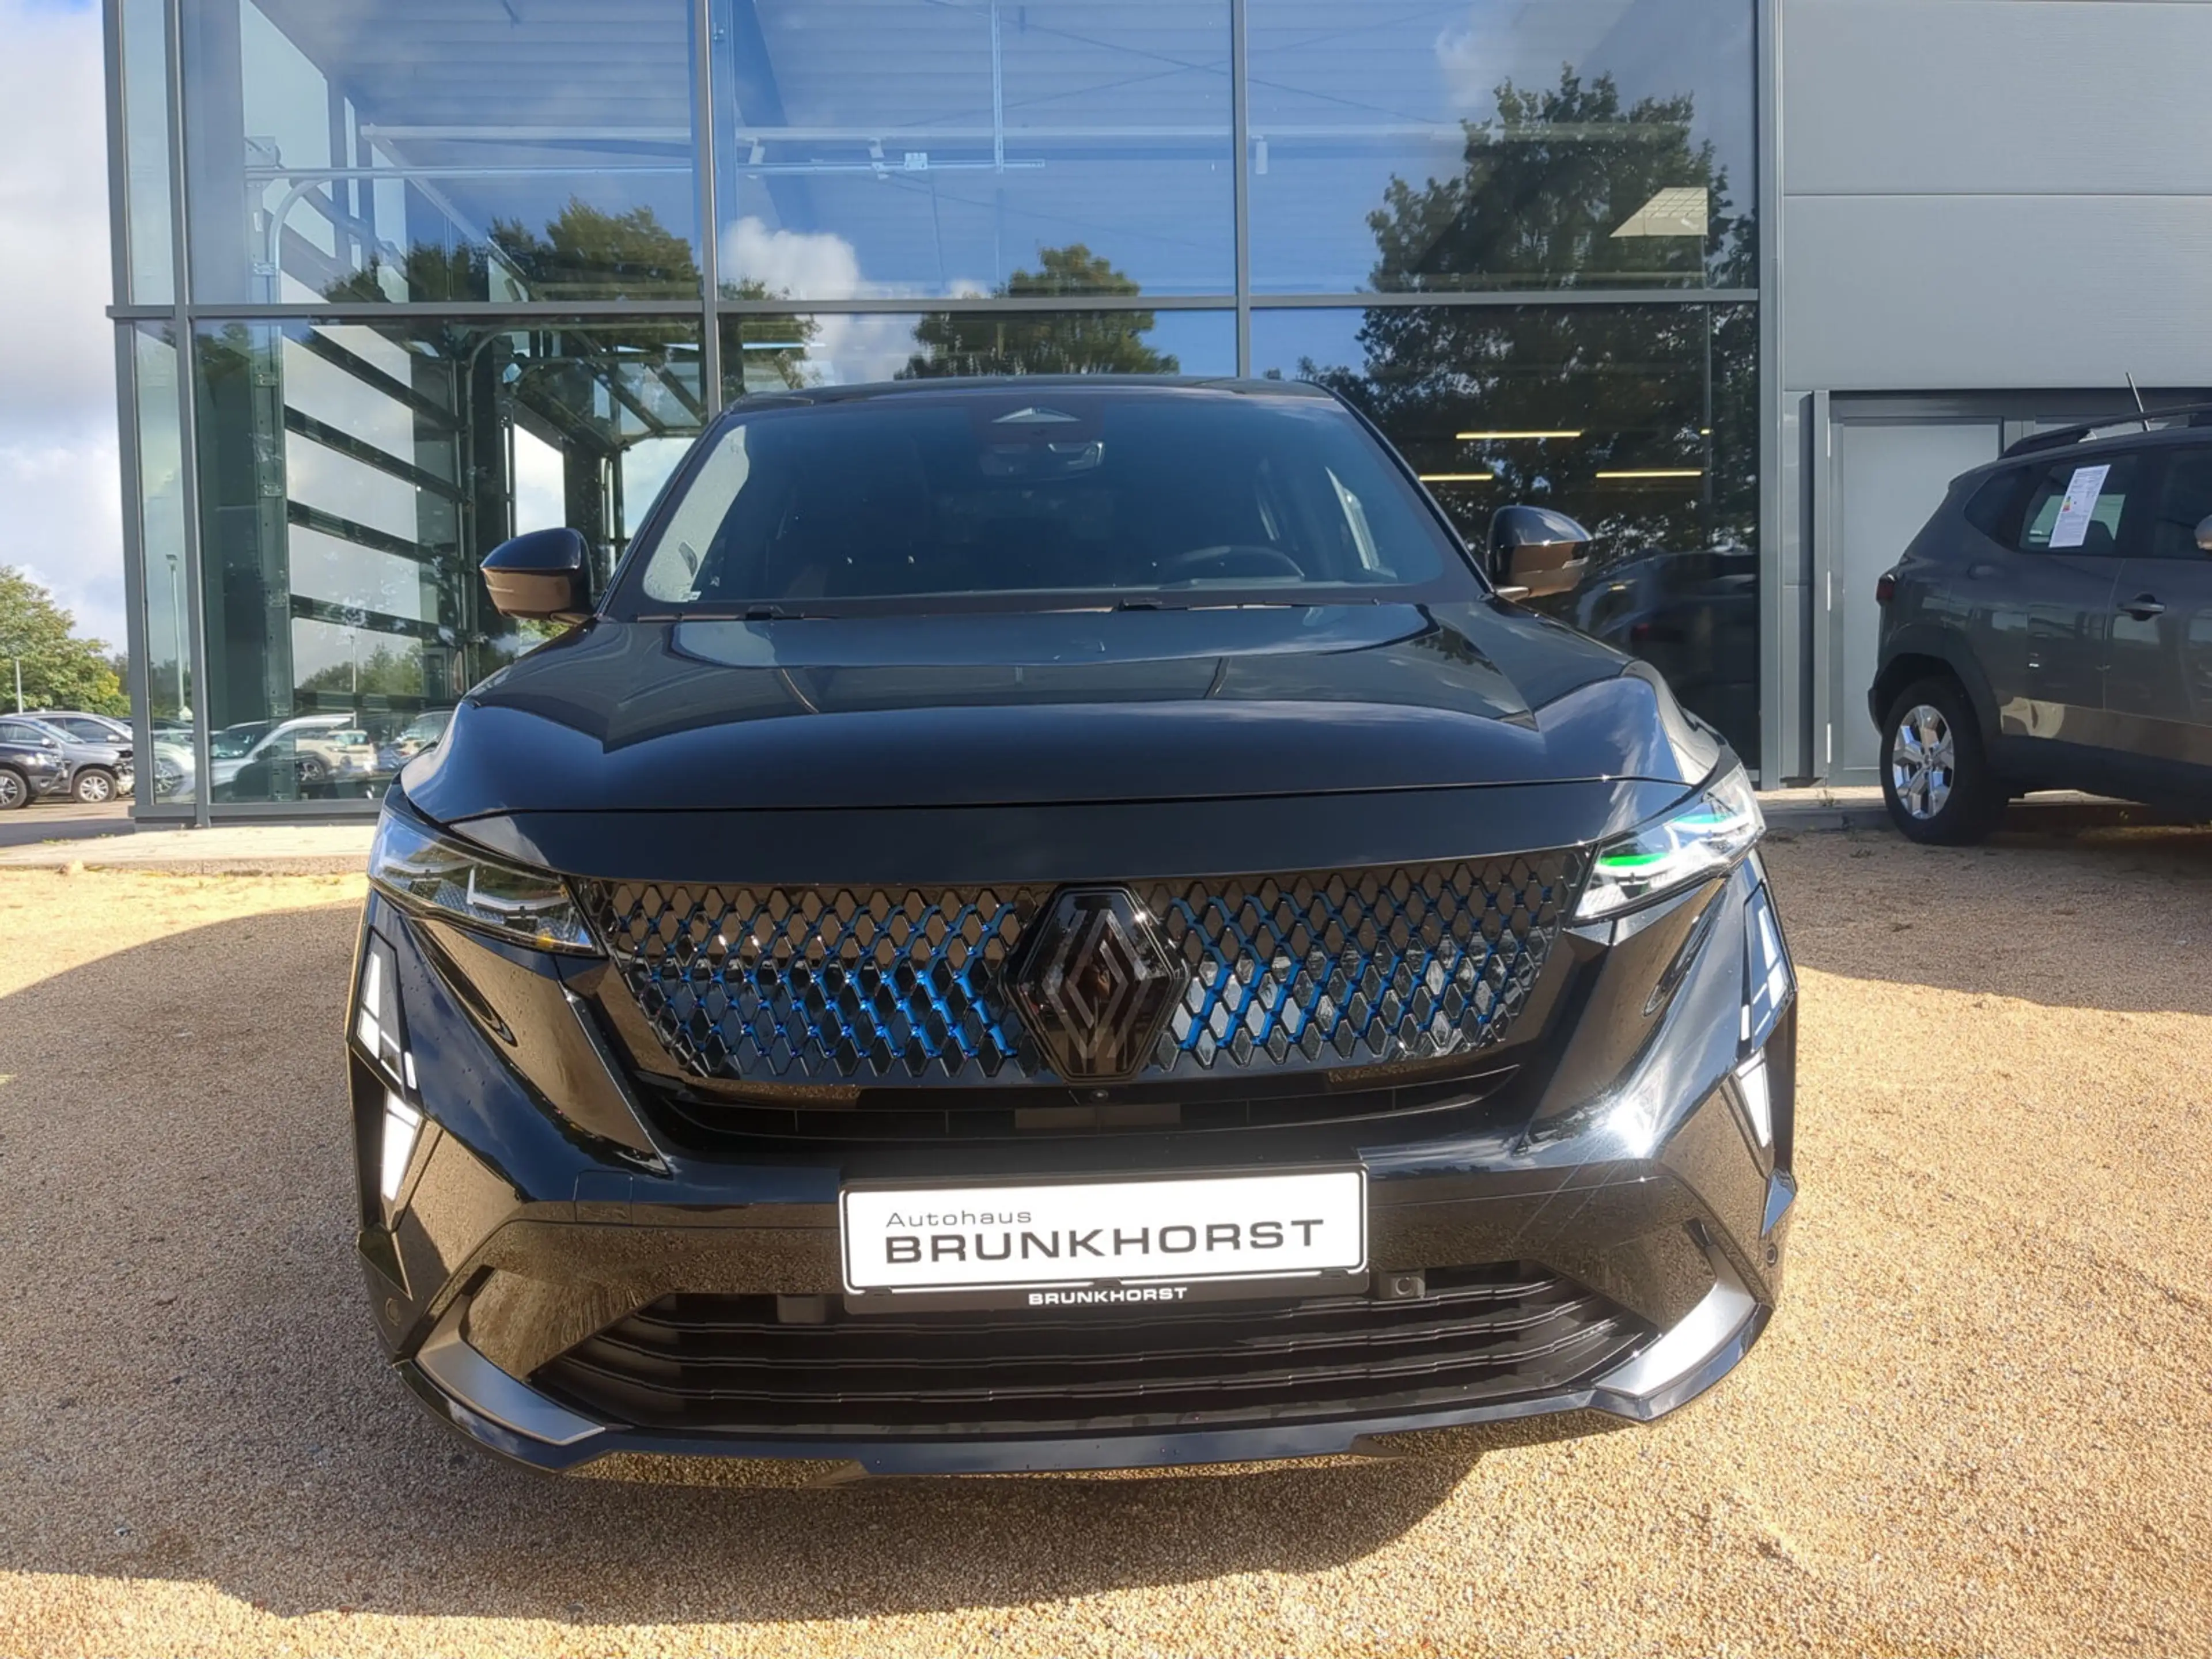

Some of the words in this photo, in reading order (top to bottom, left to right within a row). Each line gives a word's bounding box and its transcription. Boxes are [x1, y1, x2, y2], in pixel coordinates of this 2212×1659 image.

[886, 1210, 1032, 1228] Autohaus
[885, 1218, 1324, 1264] BRUNKHORST
[1028, 1287, 1188, 1305] BRUNKHORST
